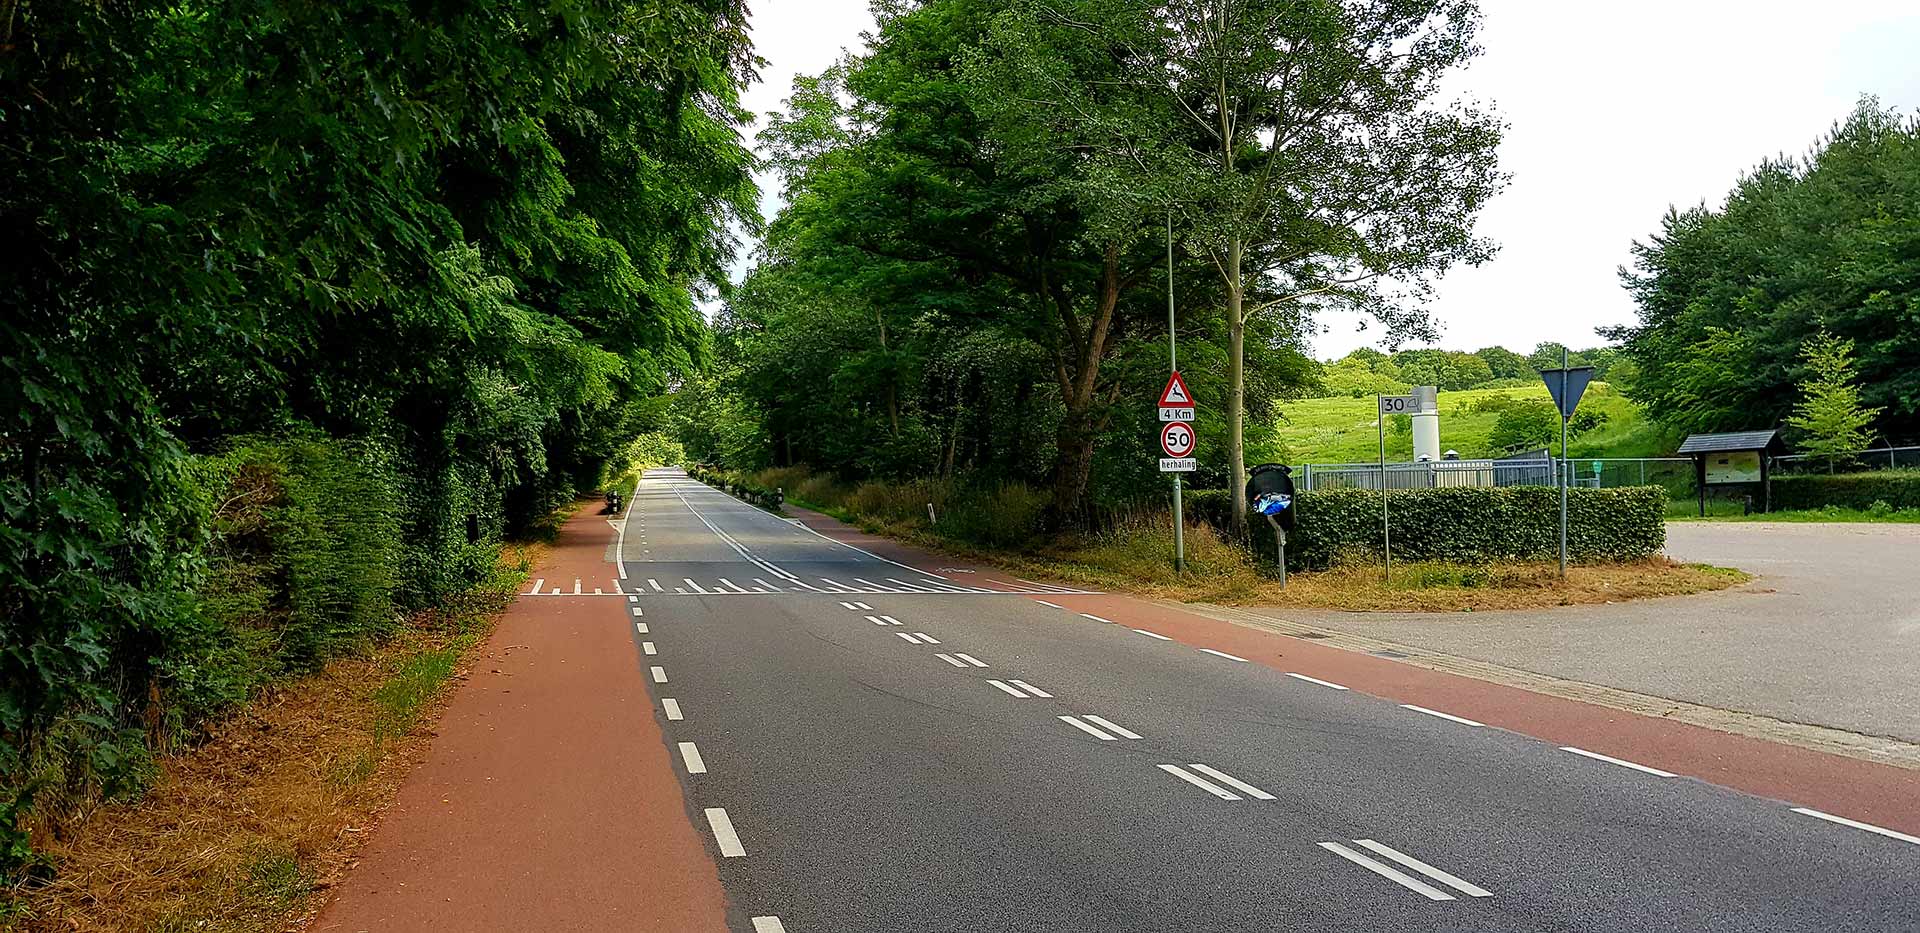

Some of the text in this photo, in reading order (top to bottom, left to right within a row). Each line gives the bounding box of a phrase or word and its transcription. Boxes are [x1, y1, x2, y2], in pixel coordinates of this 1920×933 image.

[1384, 398, 1405, 412] 30
[1164, 409, 1192, 419] 4 Km
[1167, 432, 1190, 447] 50
[1161, 460, 1196, 470] herhaling
